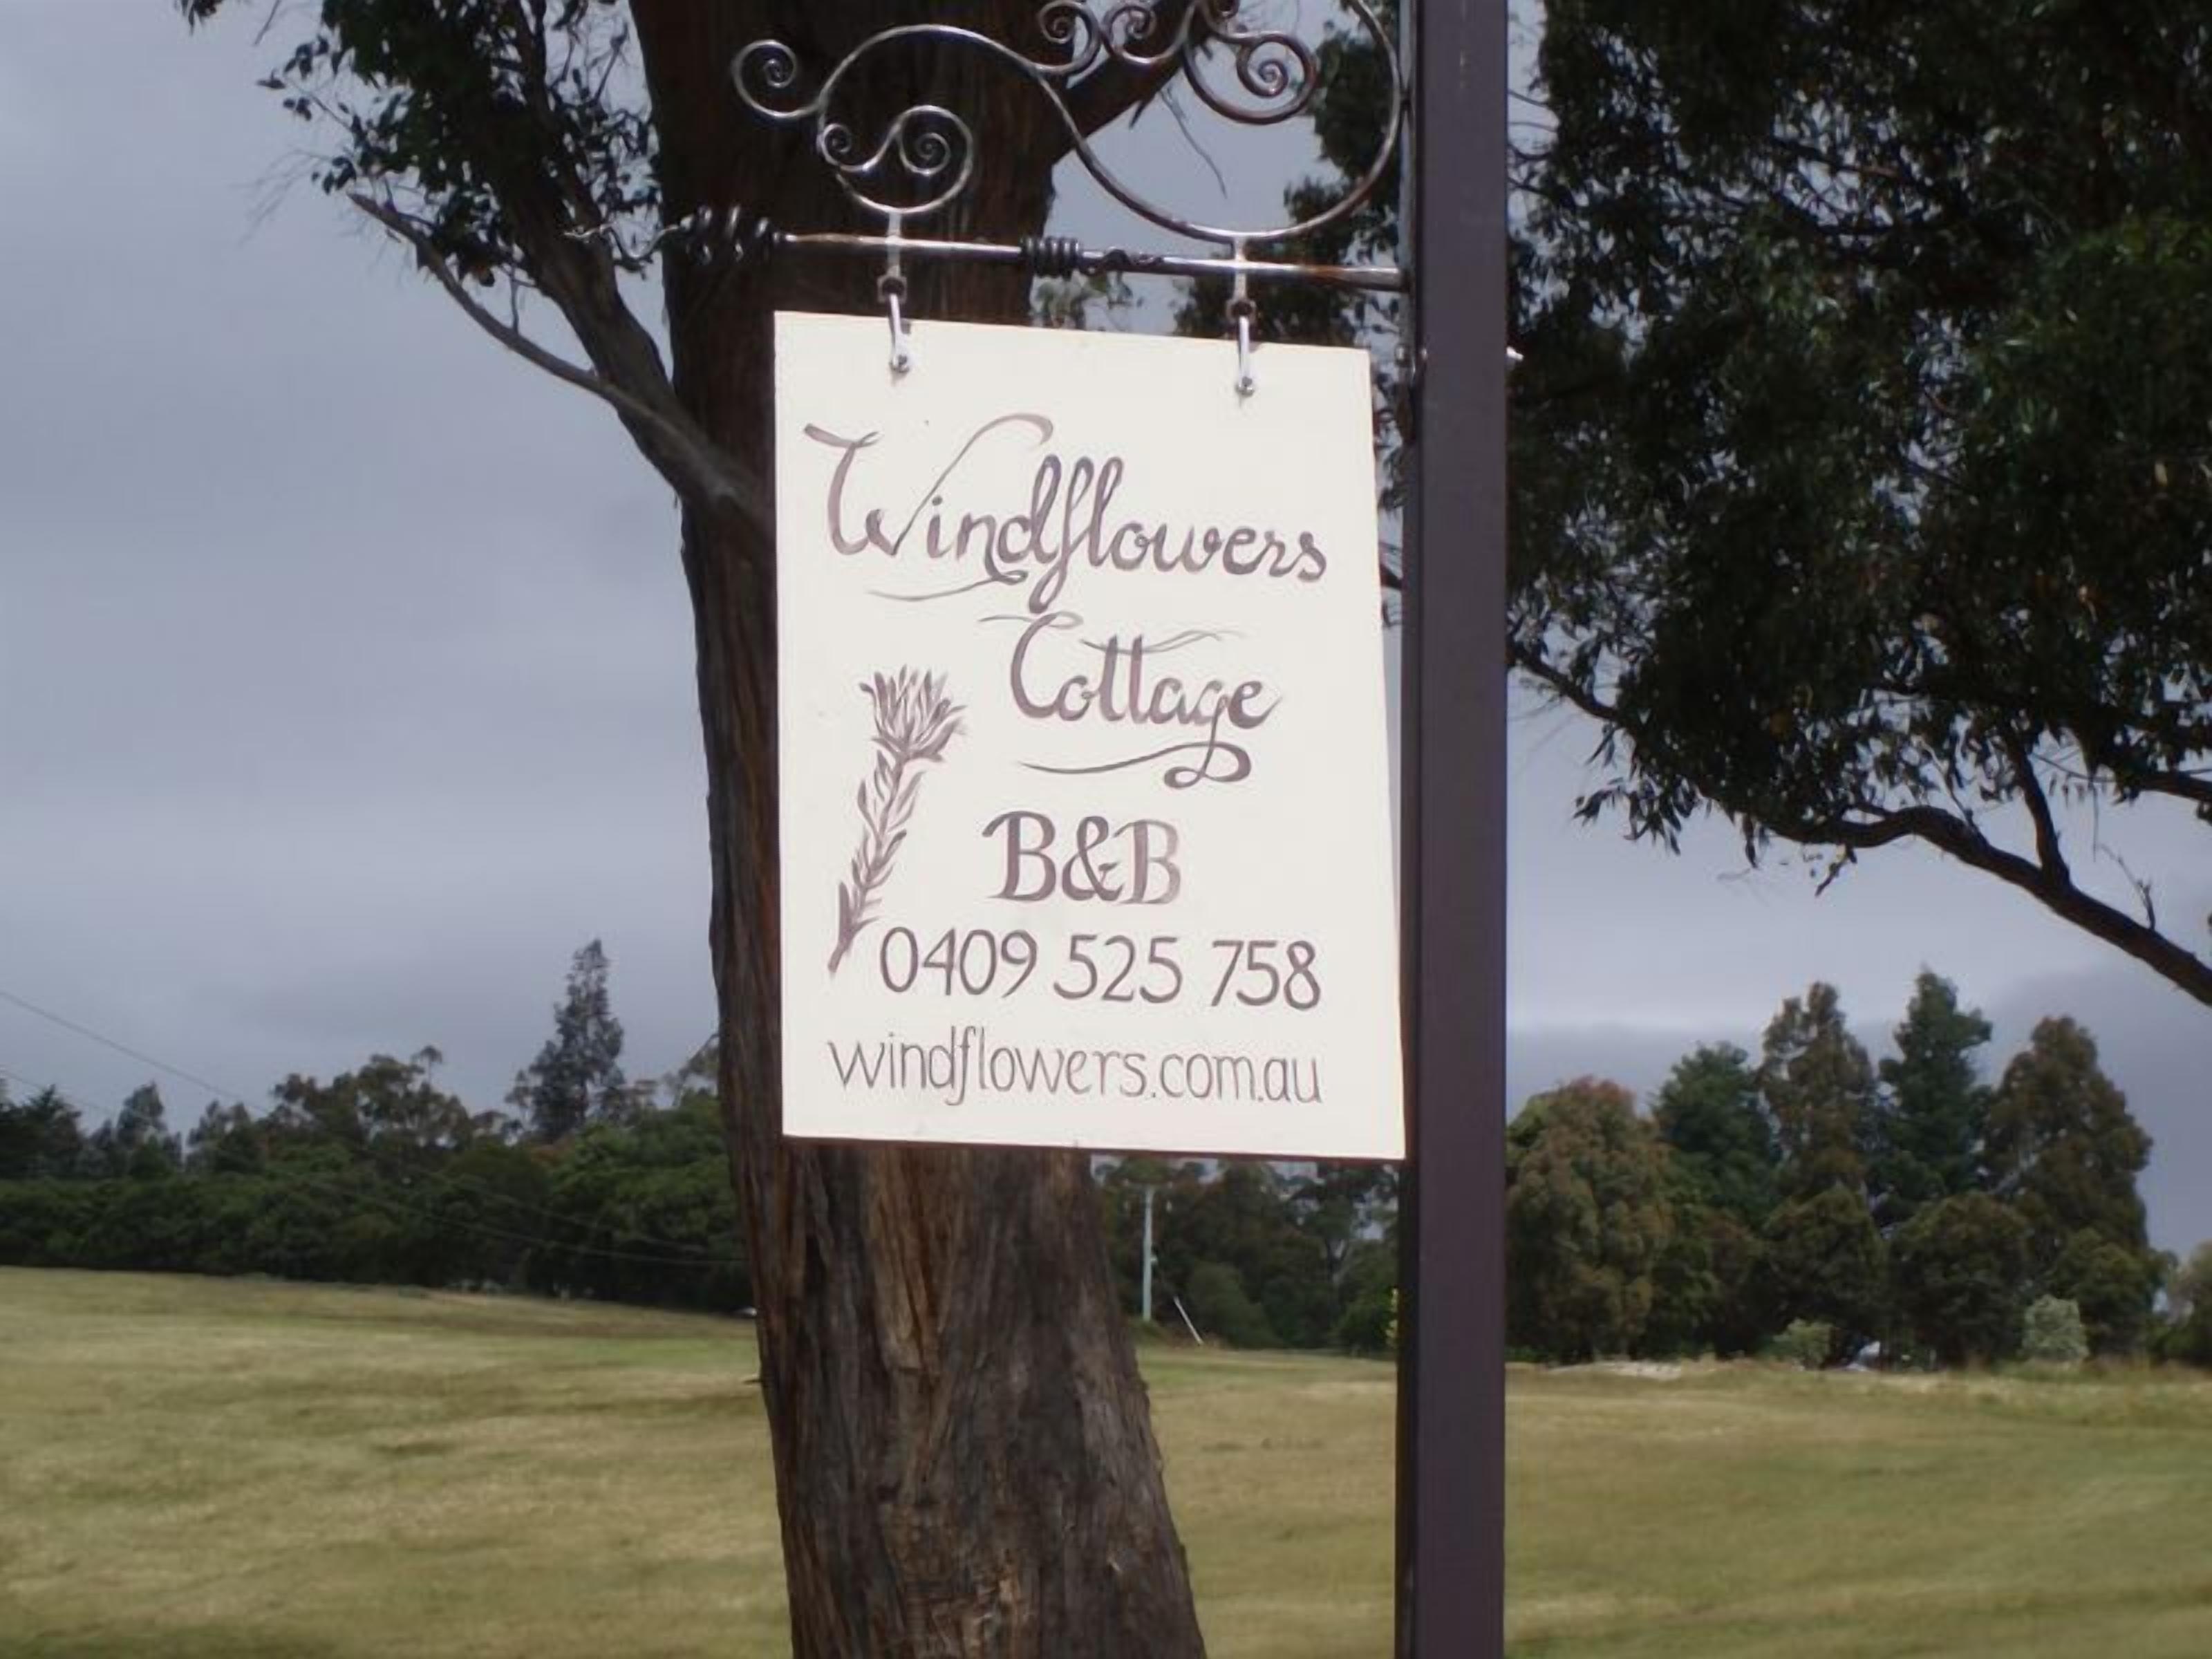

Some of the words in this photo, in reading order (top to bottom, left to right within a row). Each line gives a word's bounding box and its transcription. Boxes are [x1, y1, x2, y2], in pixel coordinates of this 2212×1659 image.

[803, 413, 1328, 614] Windflowers
[980, 612, 1281, 789] Cottage
[982, 810, 1181, 905] B&B
[879, 926, 1038, 998] 0409
[1053, 934, 1183, 1004] 525
[1211, 939, 1322, 1011] 758
[827, 1025, 1323, 1107] windflowers.com.au
